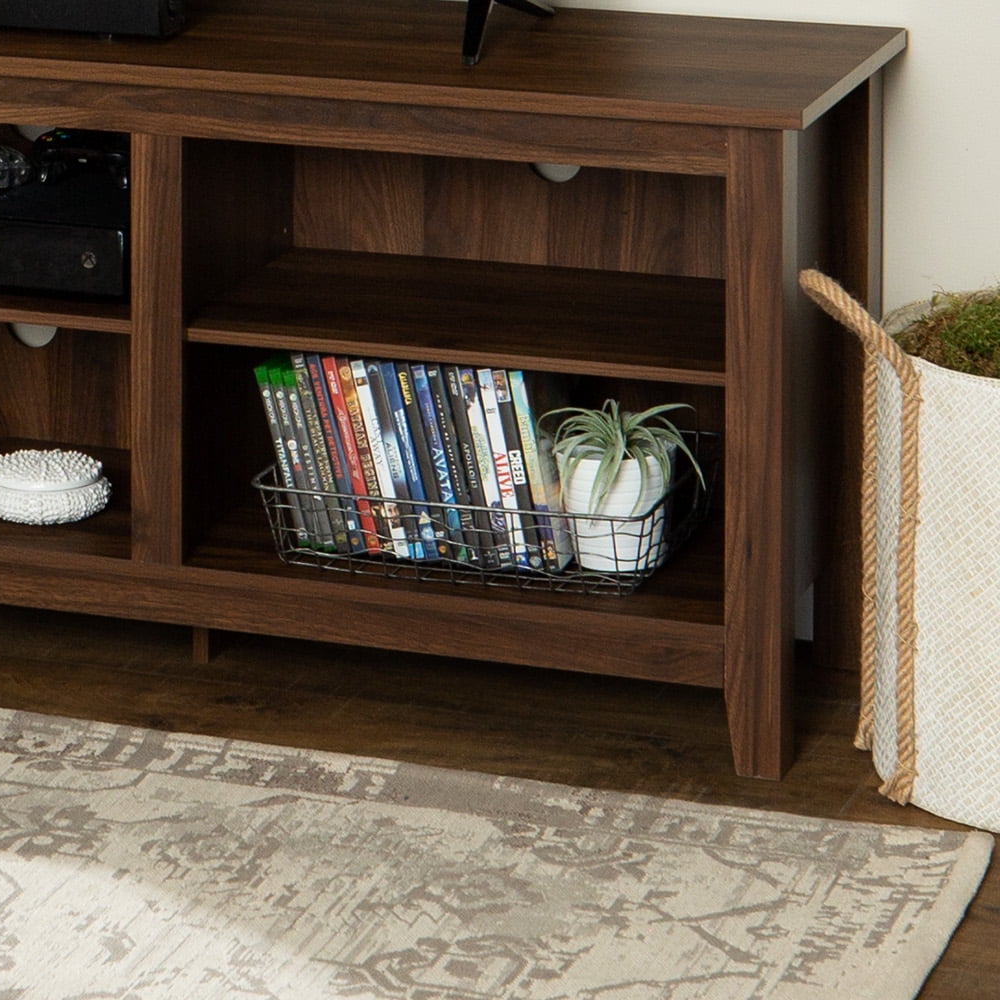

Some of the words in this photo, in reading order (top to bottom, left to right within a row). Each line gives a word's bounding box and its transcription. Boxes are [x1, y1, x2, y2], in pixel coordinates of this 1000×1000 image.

[274, 437, 292, 488] TITANFALL
[346, 399, 368, 450] BATMAN
[359, 453, 379, 498] BEGINS
[462, 442, 475, 477] APOLLO
[508, 449, 526, 485] CREED
[431, 446, 457, 513] AVATA
[492, 450, 514, 498] ALIVE
